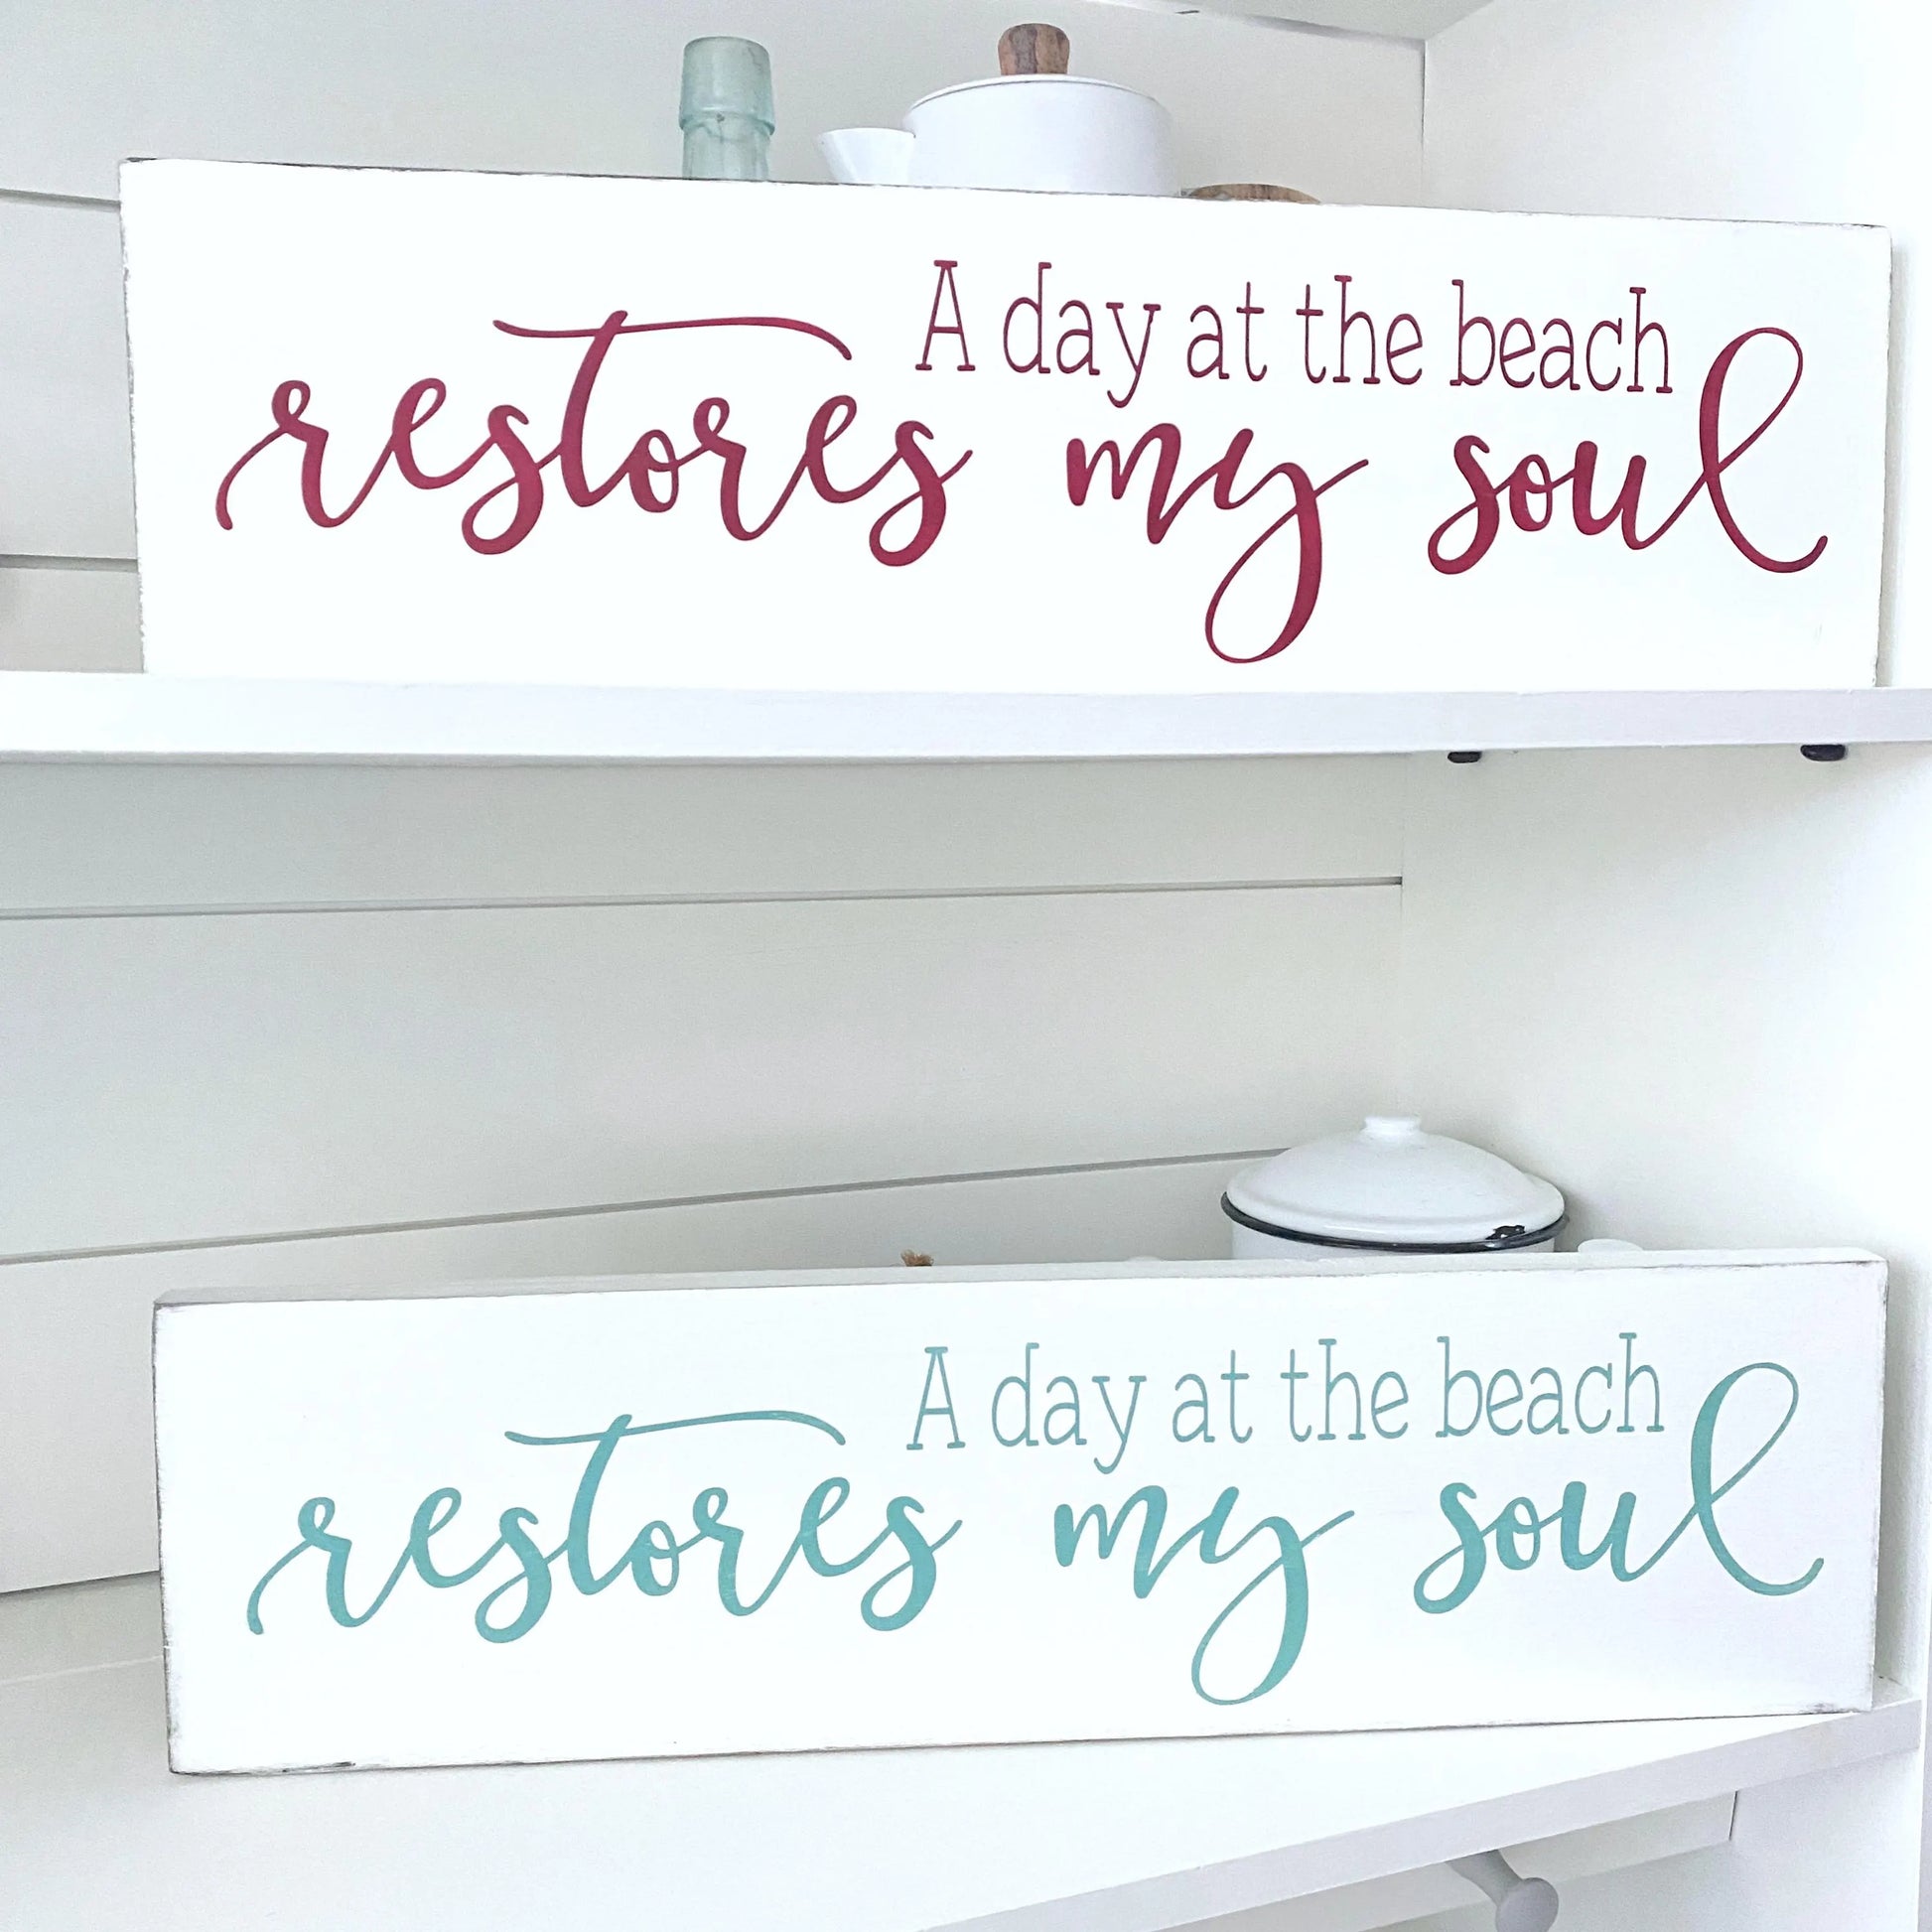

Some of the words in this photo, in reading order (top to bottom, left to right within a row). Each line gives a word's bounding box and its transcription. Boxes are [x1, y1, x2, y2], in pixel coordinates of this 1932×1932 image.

[915, 259, 976, 372] A
[1003, 261, 1162, 409] day
[1186, 281, 1268, 382] at
[1296, 274, 1424, 386] the
[1449, 279, 1674, 394] beach
[215, 310, 973, 568] restores
[1065, 422, 1369, 665] my
[1428, 327, 1828, 576] soul
[905, 1346, 966, 1450] A
[991, 1342, 1146, 1473] day
[1172, 1348, 1254, 1445] at
[1281, 1338, 1410, 1441] the
[1436, 1332, 1665, 1438] beach
[247, 1413, 962, 1643] restores
[1053, 1485, 1355, 1706] my
[1413, 1361, 1824, 1614] soul
